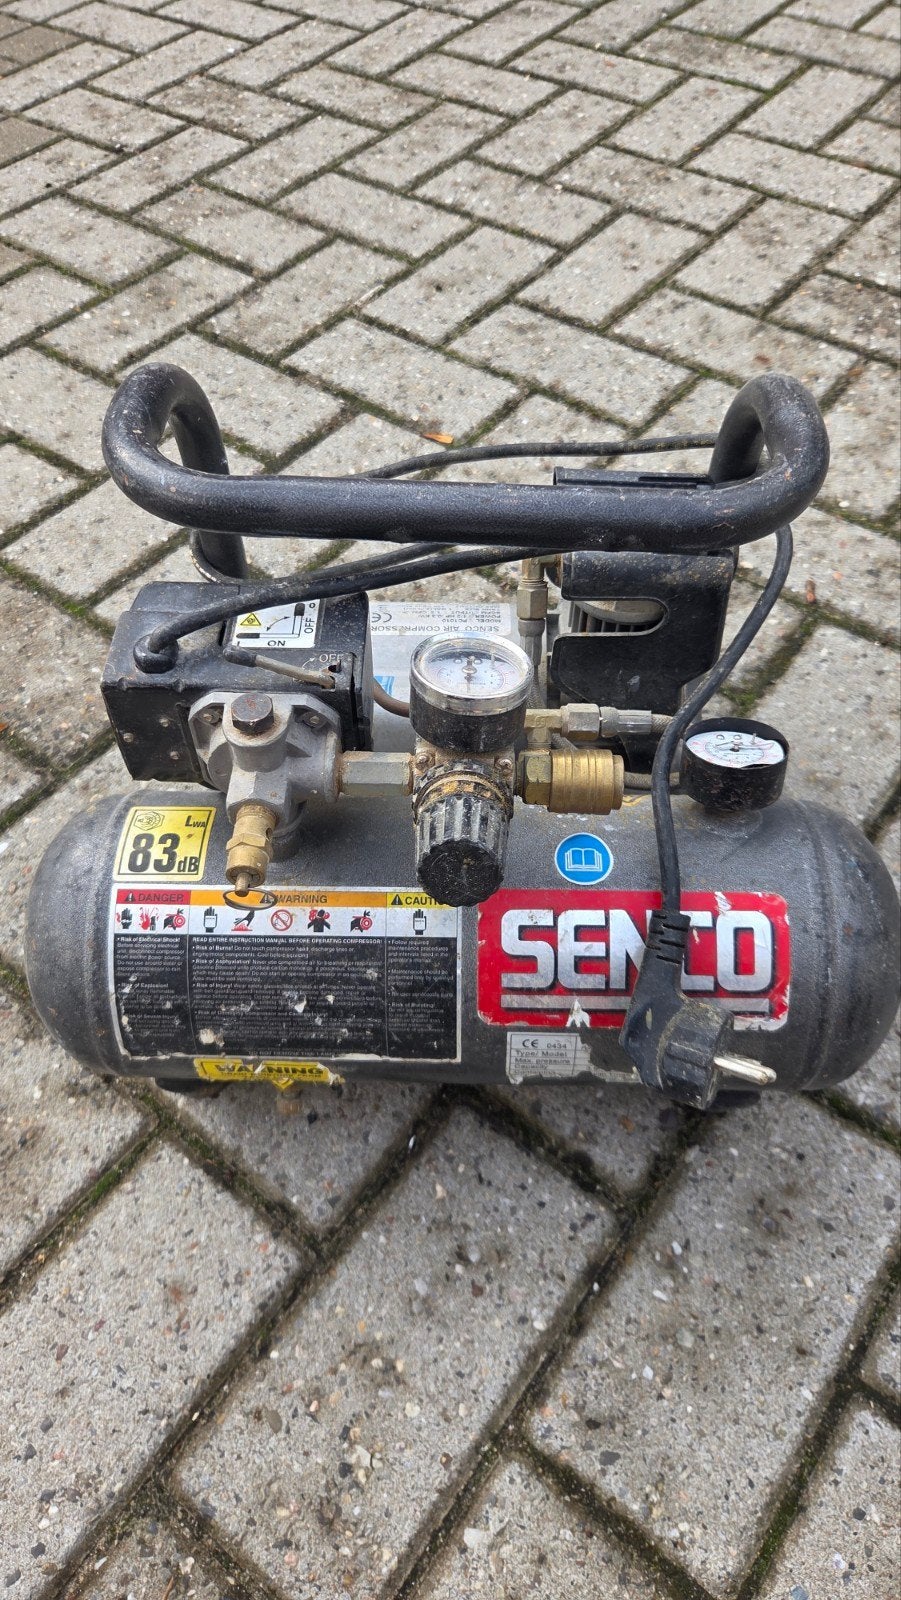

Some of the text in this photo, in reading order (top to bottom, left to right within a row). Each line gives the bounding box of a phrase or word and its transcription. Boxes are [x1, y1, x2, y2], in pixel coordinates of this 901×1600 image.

[304, 618, 316, 634] OFF
[128, 833, 180, 873] 83
[138, 893, 184, 902] DANGER
[276, 895, 327, 903] WARNING
[405, 896, 444, 905] CAUTI
[214, 1064, 324, 1074] WANING
